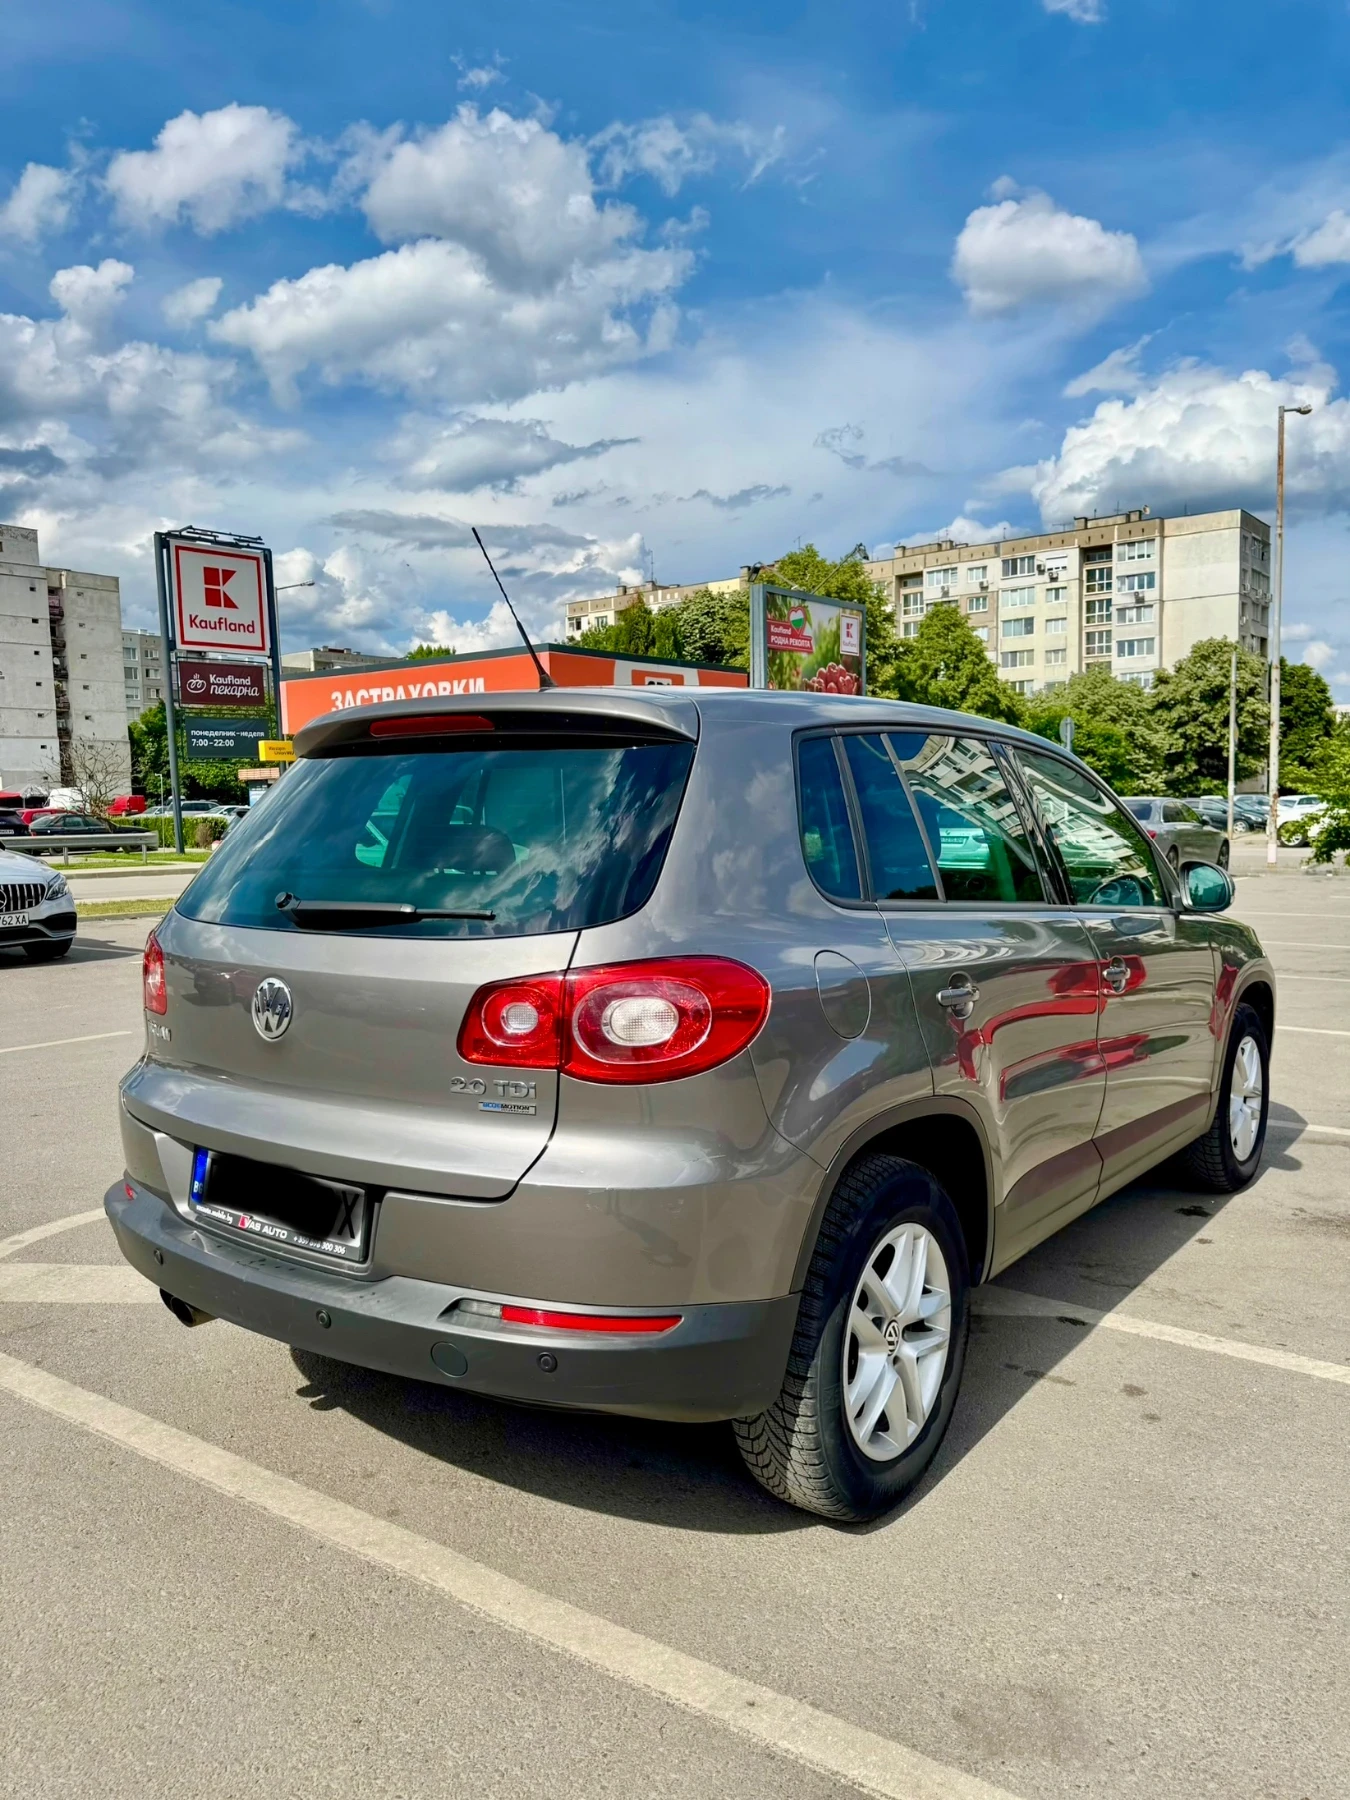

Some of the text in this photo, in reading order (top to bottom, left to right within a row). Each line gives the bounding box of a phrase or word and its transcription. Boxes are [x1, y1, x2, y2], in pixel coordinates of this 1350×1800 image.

[189, 614, 255, 634] Kaufland
[771, 624, 792, 635] Kaufland
[209, 674, 251, 685] Kaufland
[210, 685, 260, 698] пекарна
[0, 914, 27, 925] 62 XA
[493, 1080, 536, 1099] TDI
[262, 1225, 288, 1239] AUTO
